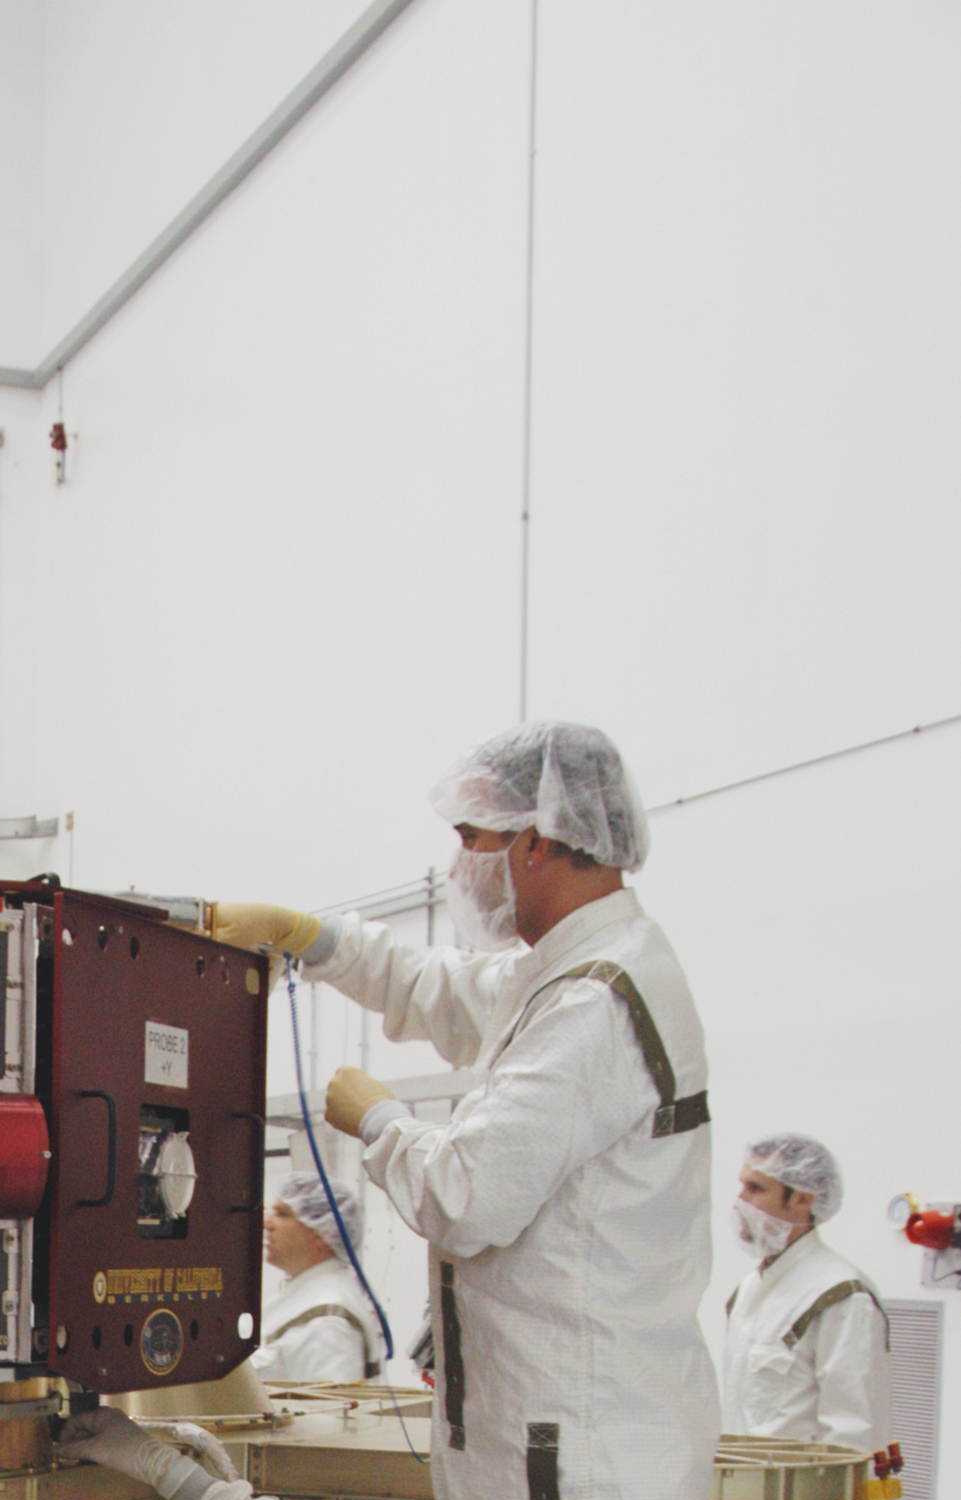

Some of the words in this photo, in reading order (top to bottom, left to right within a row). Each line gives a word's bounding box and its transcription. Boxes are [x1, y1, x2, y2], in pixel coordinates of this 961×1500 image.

[148, 1031, 178, 1053] PROBE
[180, 1037, 185, 1054] 2
[107, 1290, 223, 1304] BERKELEY
